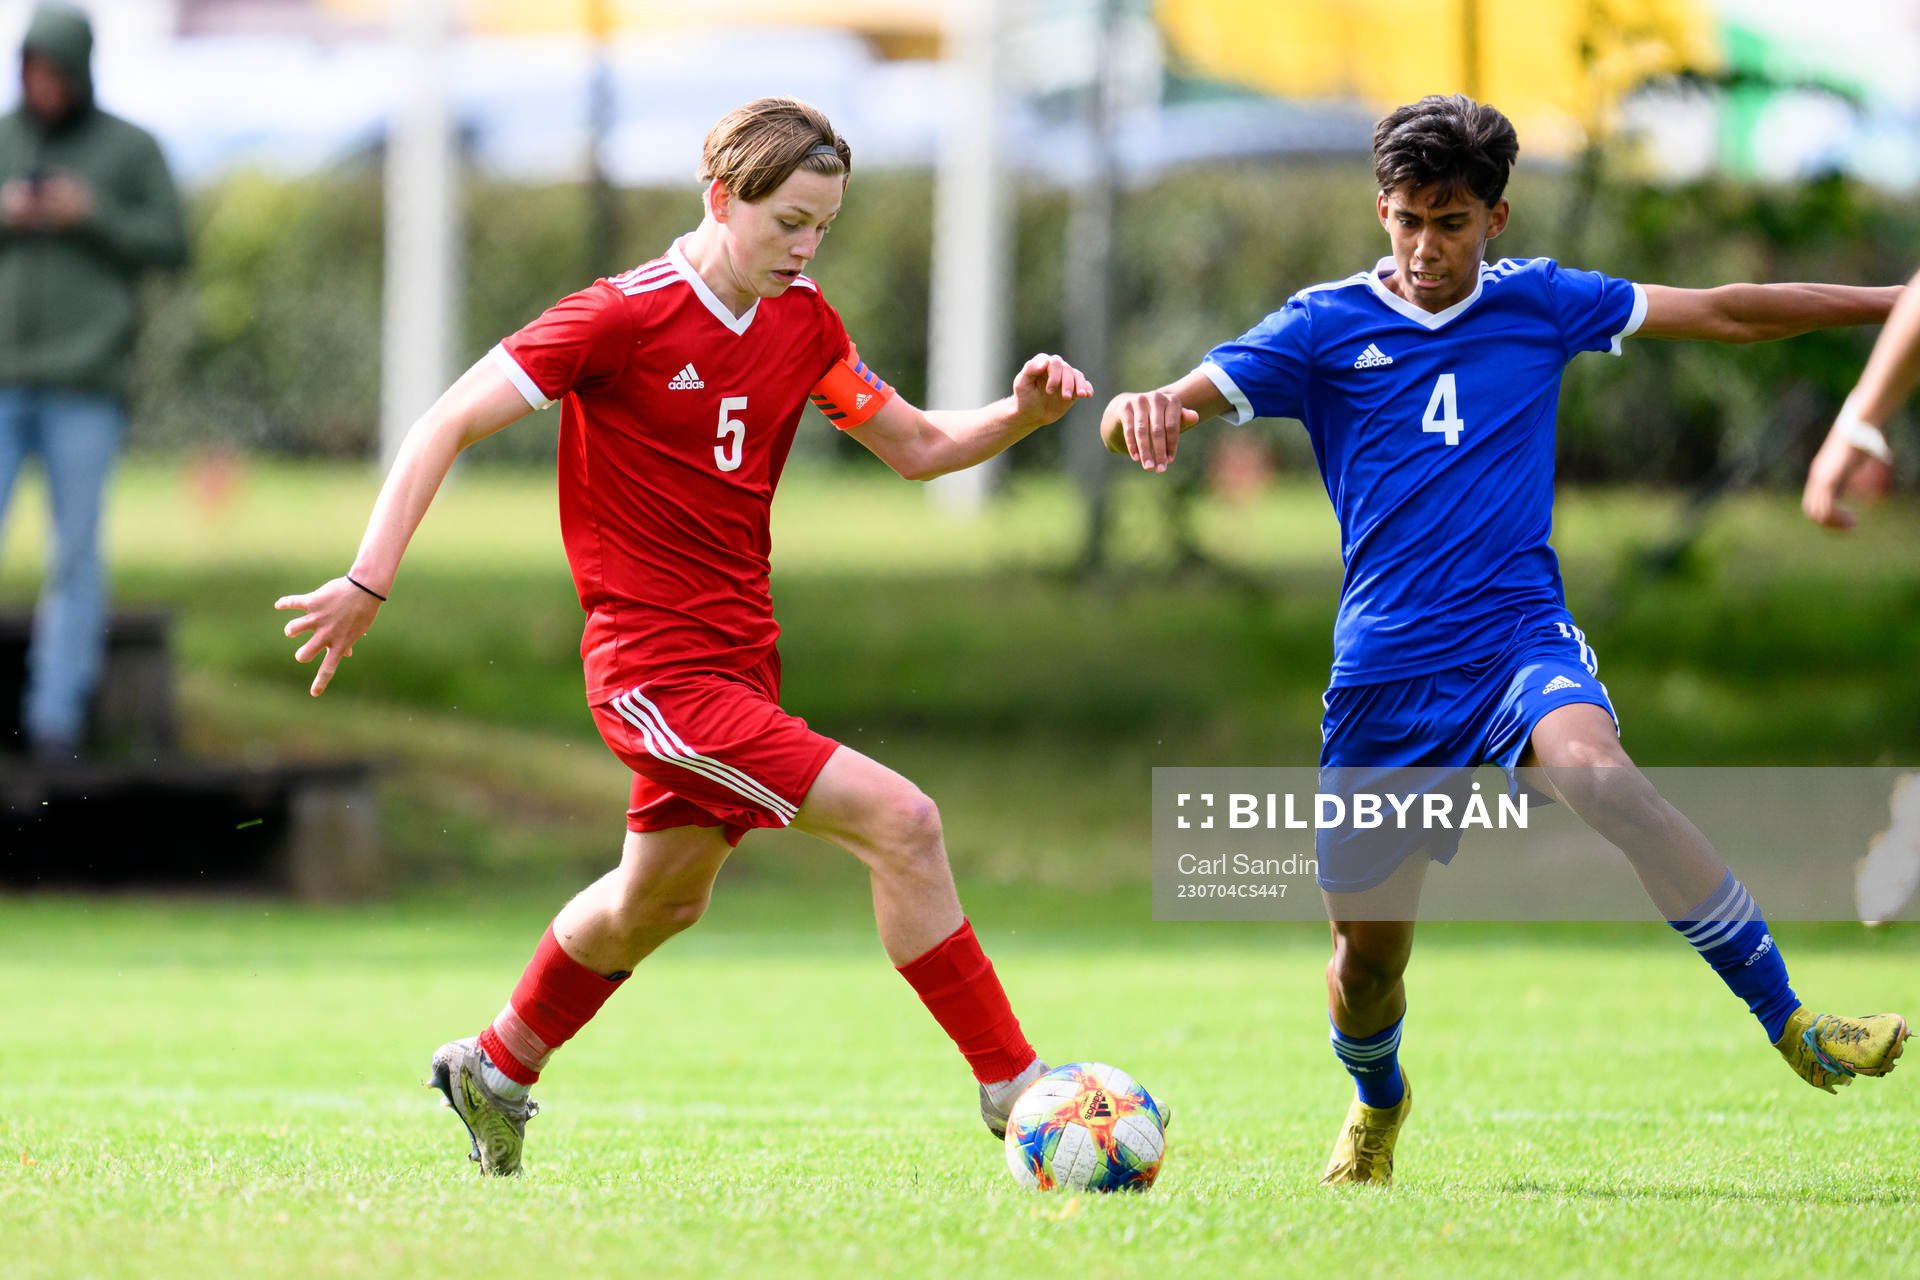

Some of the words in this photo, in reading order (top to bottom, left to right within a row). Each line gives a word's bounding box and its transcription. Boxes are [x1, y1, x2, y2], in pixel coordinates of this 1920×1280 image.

[1354, 355, 1393, 369] adidas
[668, 379, 705, 390] adidas
[1422, 373, 1464, 446] 4
[713, 396, 748, 472] 5
